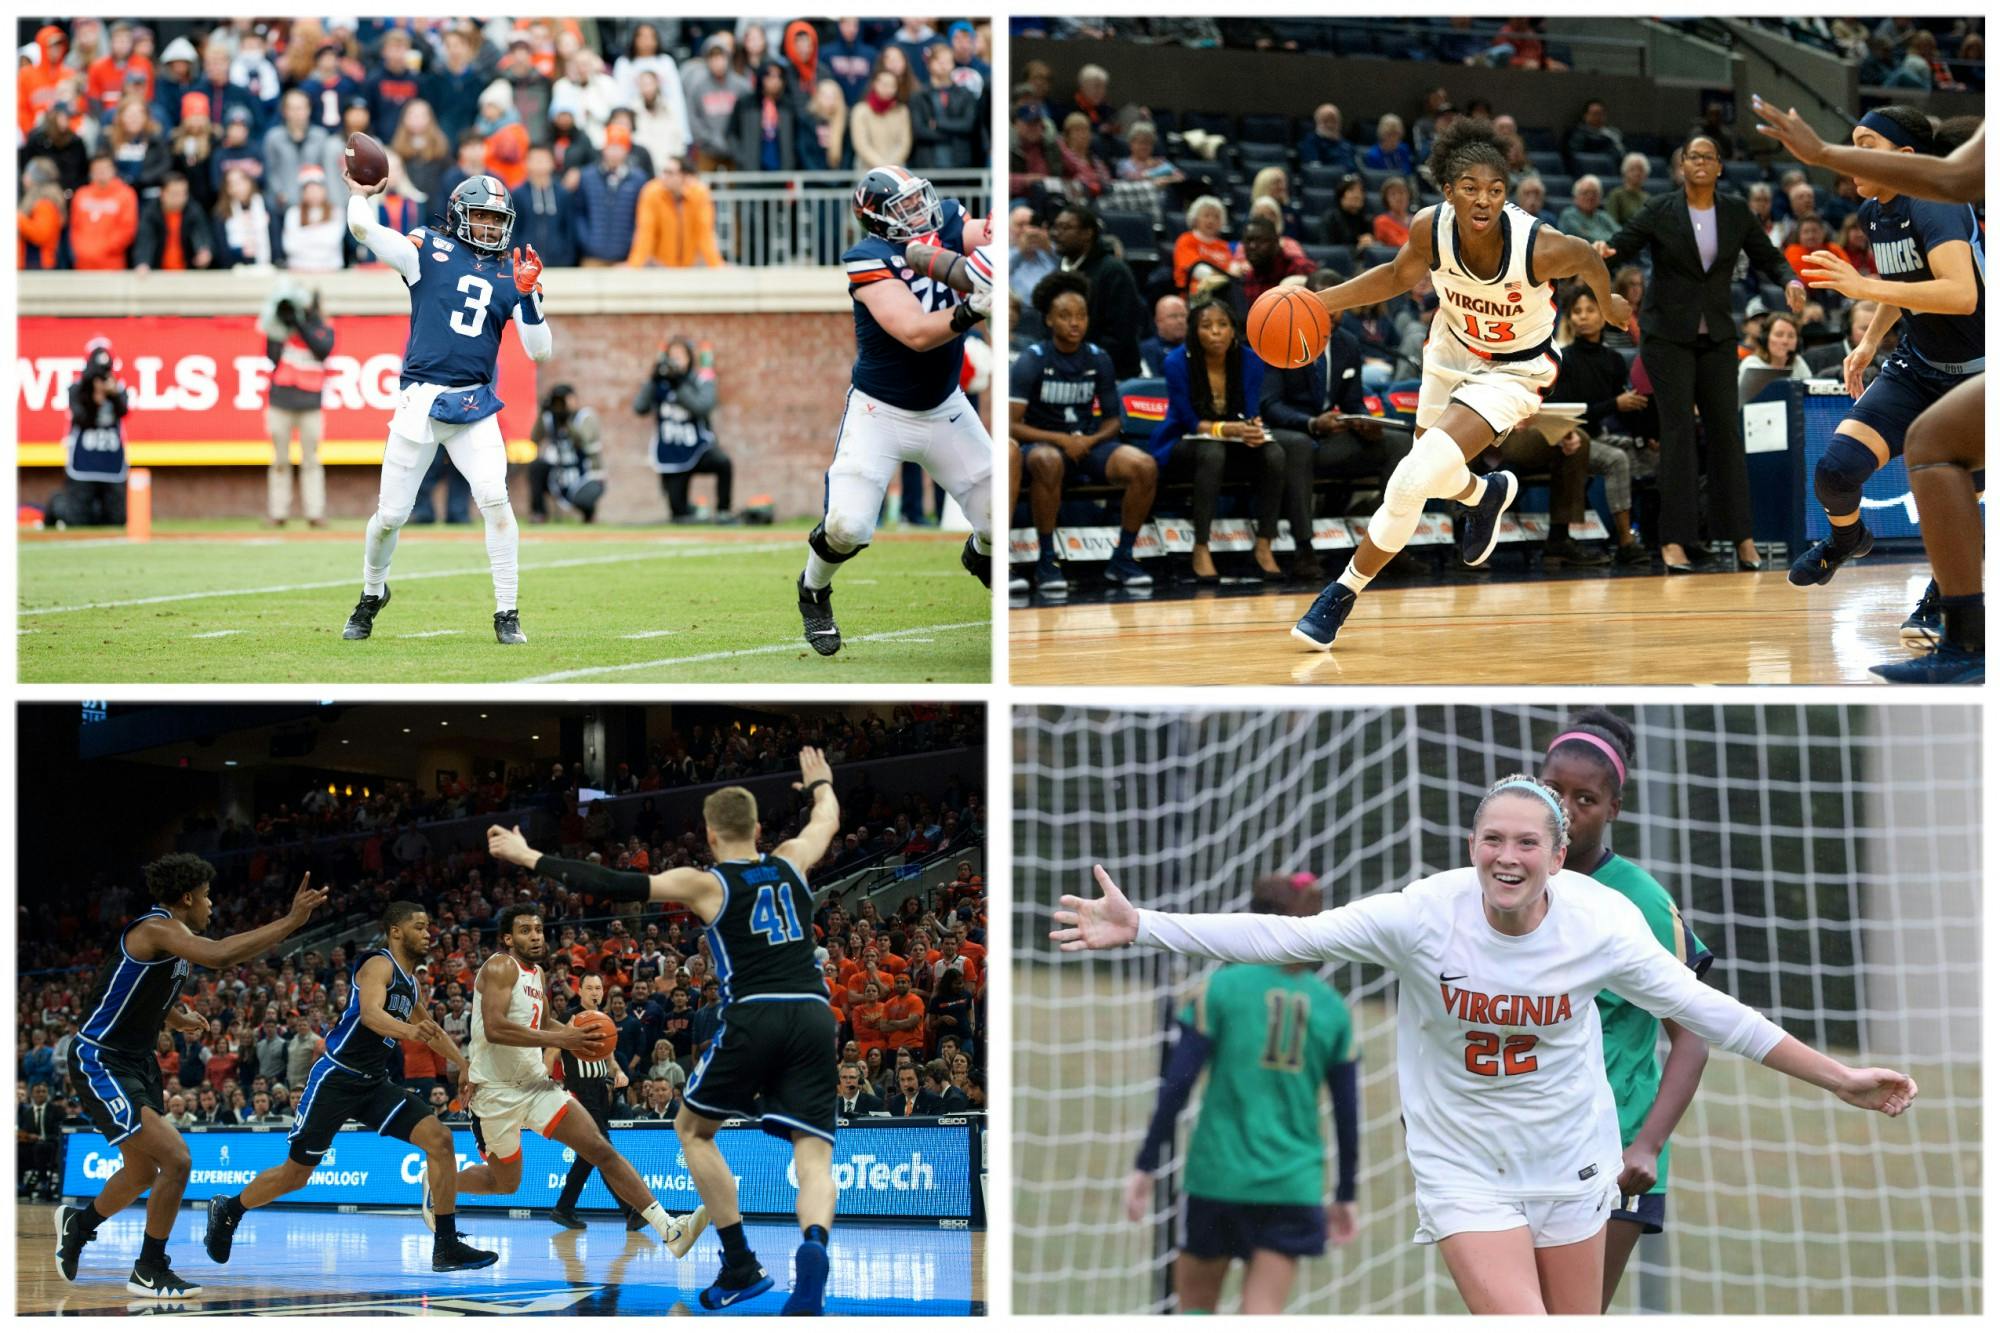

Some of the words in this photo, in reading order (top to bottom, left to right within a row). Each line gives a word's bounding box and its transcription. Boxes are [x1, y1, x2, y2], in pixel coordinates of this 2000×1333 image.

[450, 275, 493, 337] 3
[1444, 287, 1524, 317] VIRGINIA
[1463, 313, 1516, 343] 13
[749, 882, 804, 945] 41
[530, 1003, 539, 1030] 2
[1440, 983, 1572, 1027] VIRGINIA
[1259, 987, 1311, 1073] 11
[1464, 1030, 1540, 1077] 22
[938, 1117, 967, 1125] GEICO
[190, 1170, 257, 1185] EXPERIENCE
[306, 1170, 369, 1186] HNOLOGY
